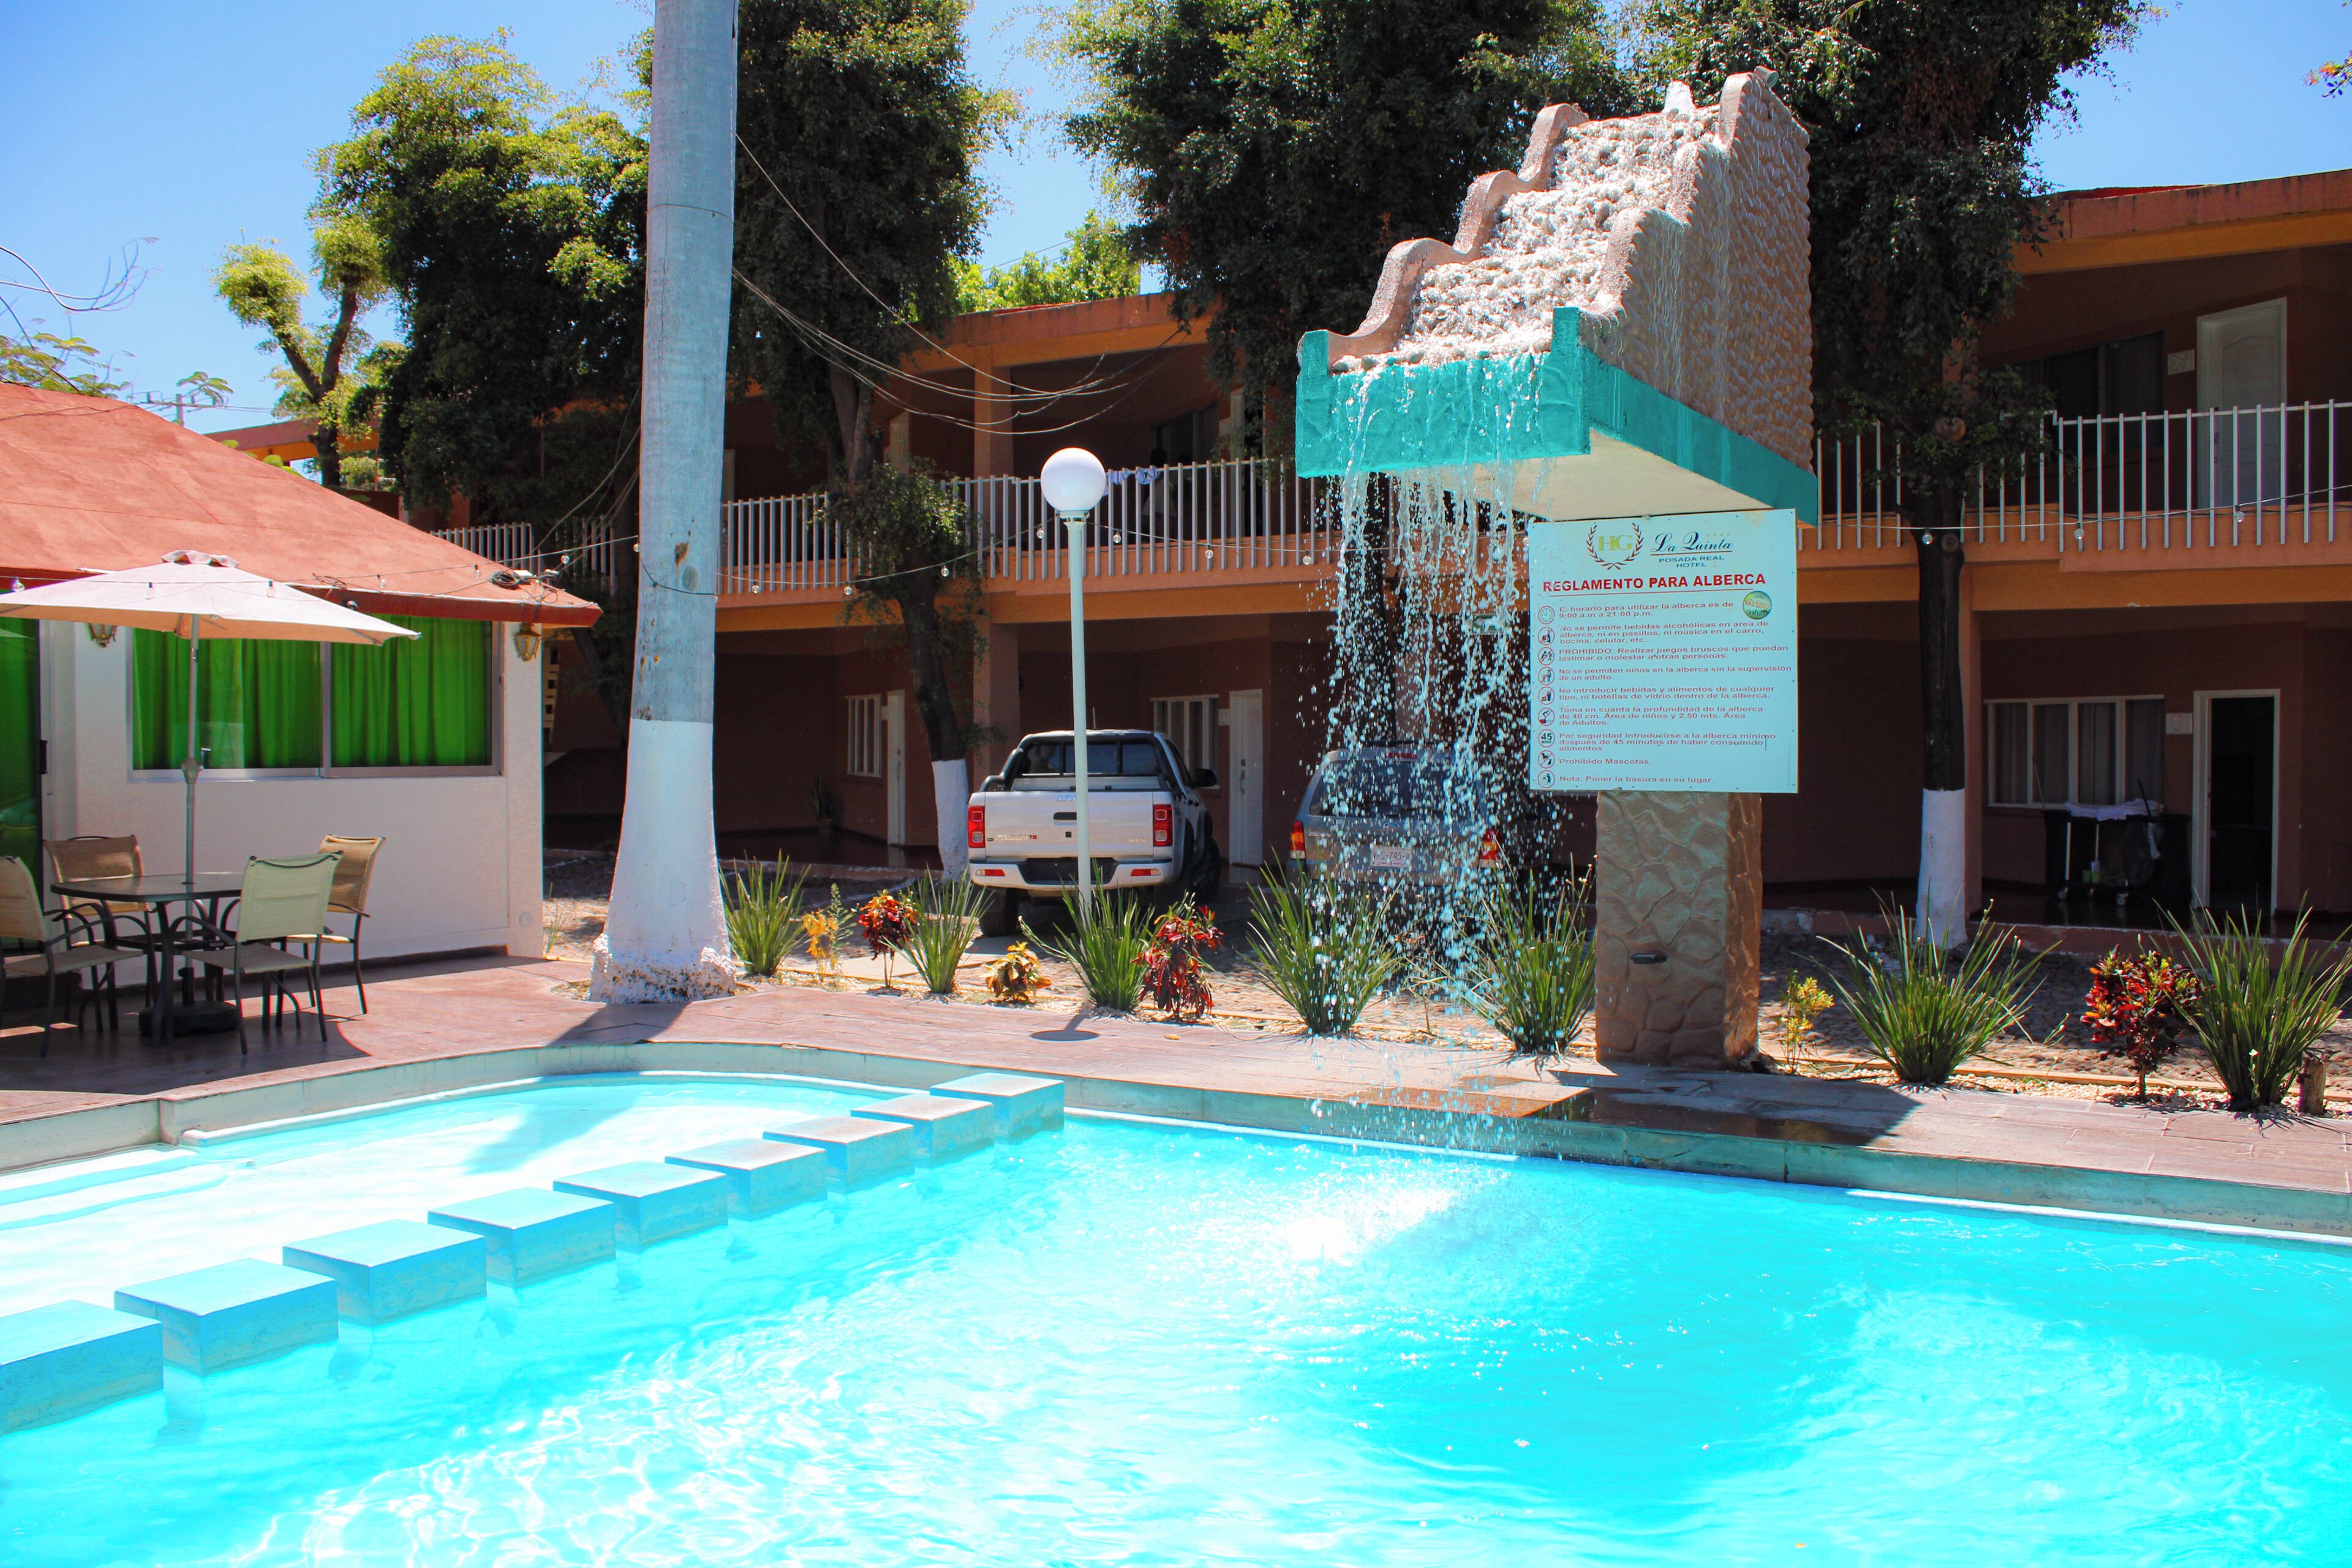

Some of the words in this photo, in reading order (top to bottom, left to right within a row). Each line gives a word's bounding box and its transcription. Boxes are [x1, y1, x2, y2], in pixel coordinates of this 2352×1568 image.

[1598, 534, 1632, 552] HG
[1651, 532, 1676, 553] La
[1681, 531, 1733, 551] Quinta
[1543, 577, 1643, 592] REGLAMENTO
[1649, 575, 1688, 589] PARA
[1693, 573, 1766, 587] ALBERCA
